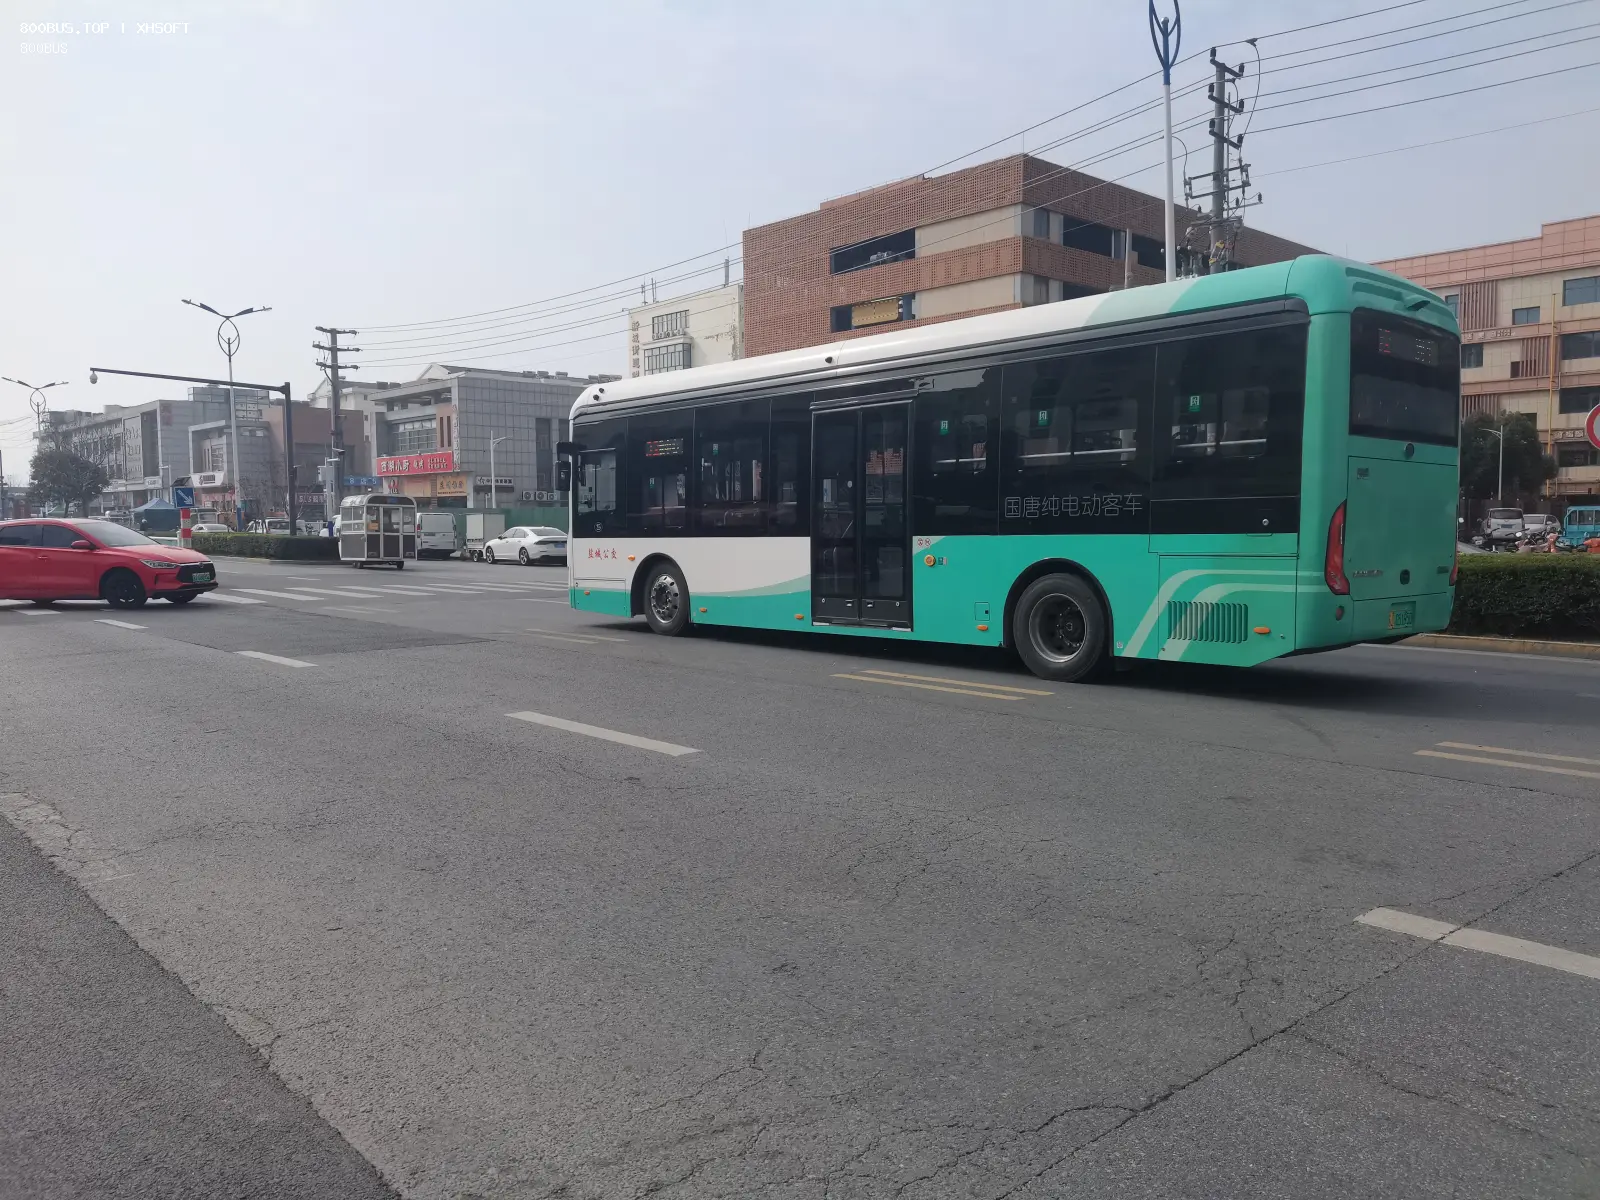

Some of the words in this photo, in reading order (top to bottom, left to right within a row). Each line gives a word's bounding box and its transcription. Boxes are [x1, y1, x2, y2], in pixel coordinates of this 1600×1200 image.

[1004, 492, 1143, 518] 国唐纯电动客车
